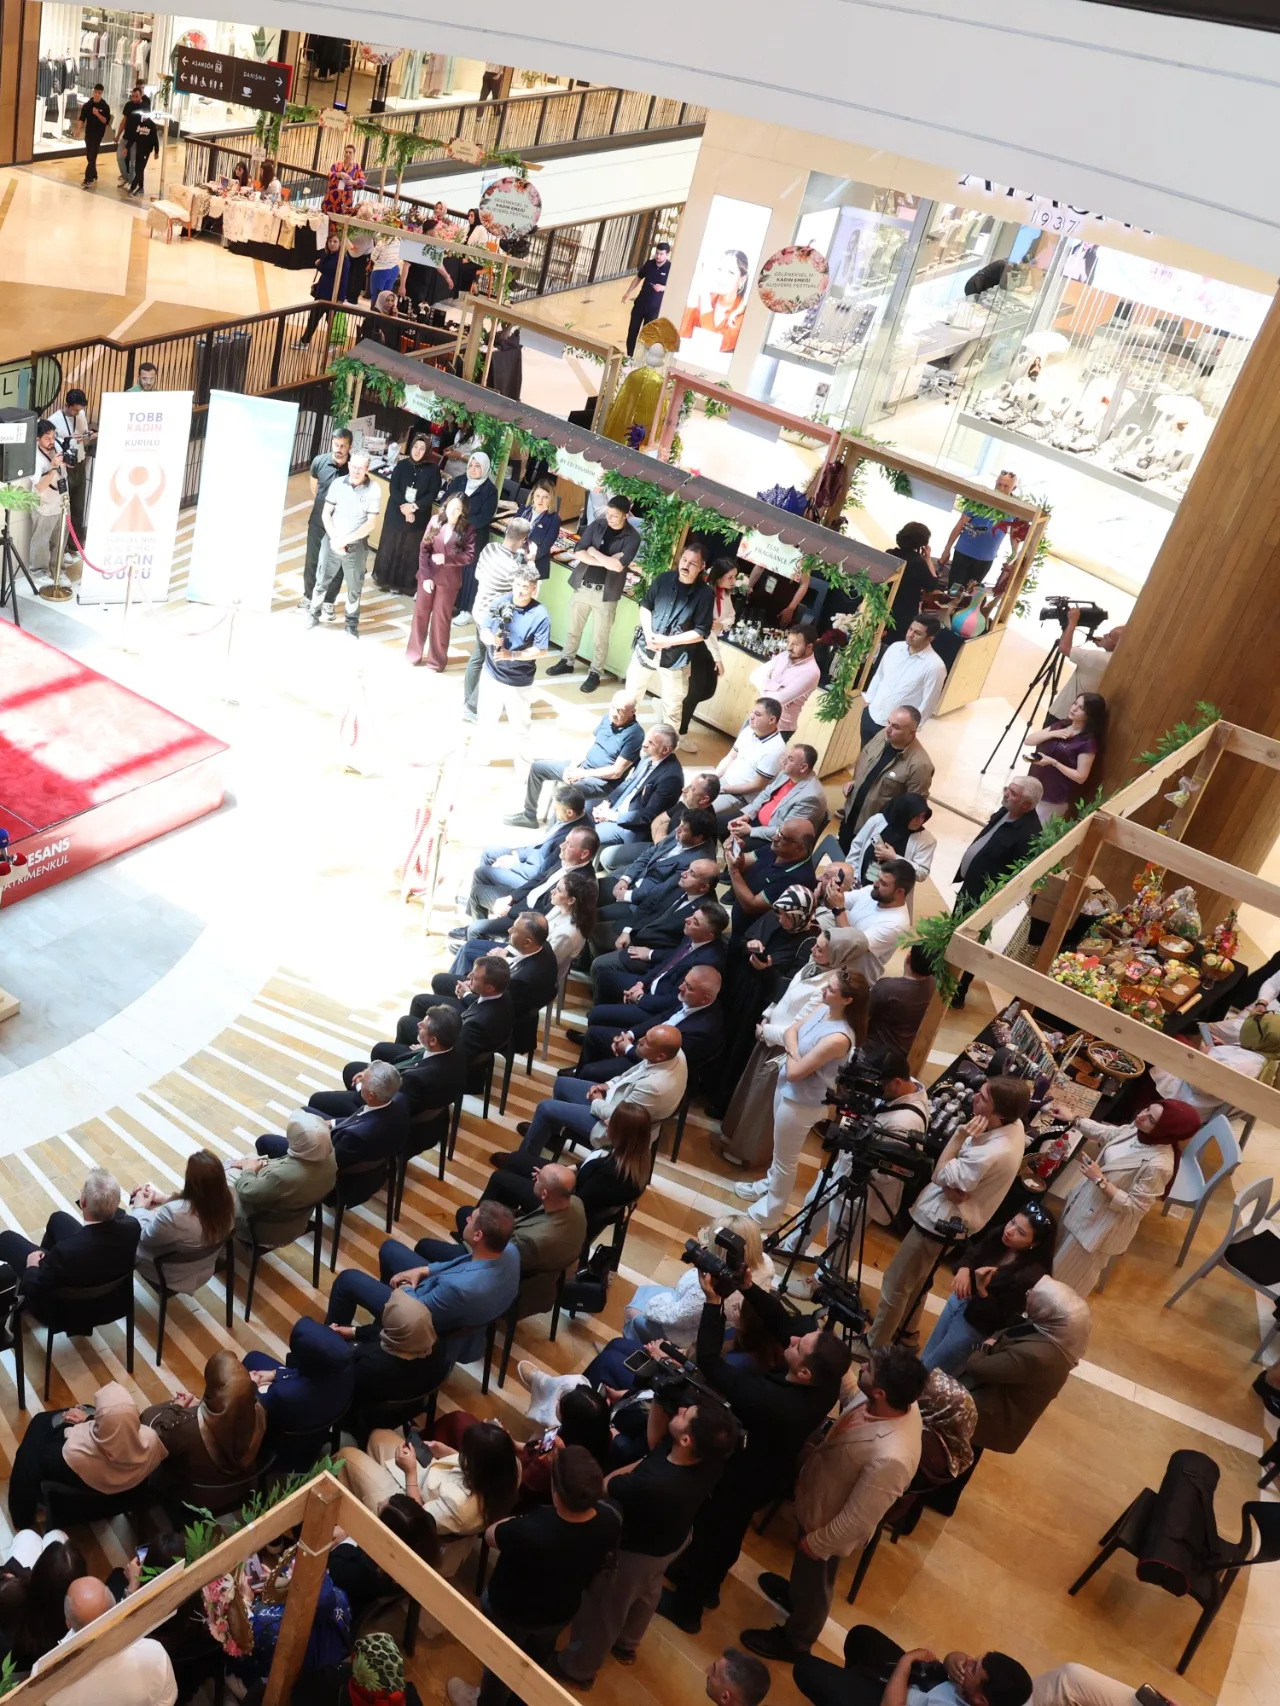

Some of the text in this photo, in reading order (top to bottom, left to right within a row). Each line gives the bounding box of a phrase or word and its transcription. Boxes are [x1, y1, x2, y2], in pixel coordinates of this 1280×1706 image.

[1031, 210, 1080, 233] 1937
[128, 412, 163, 423] TOBB
[126, 423, 162, 433] KADIN
[125, 439, 160, 447] KURULU
